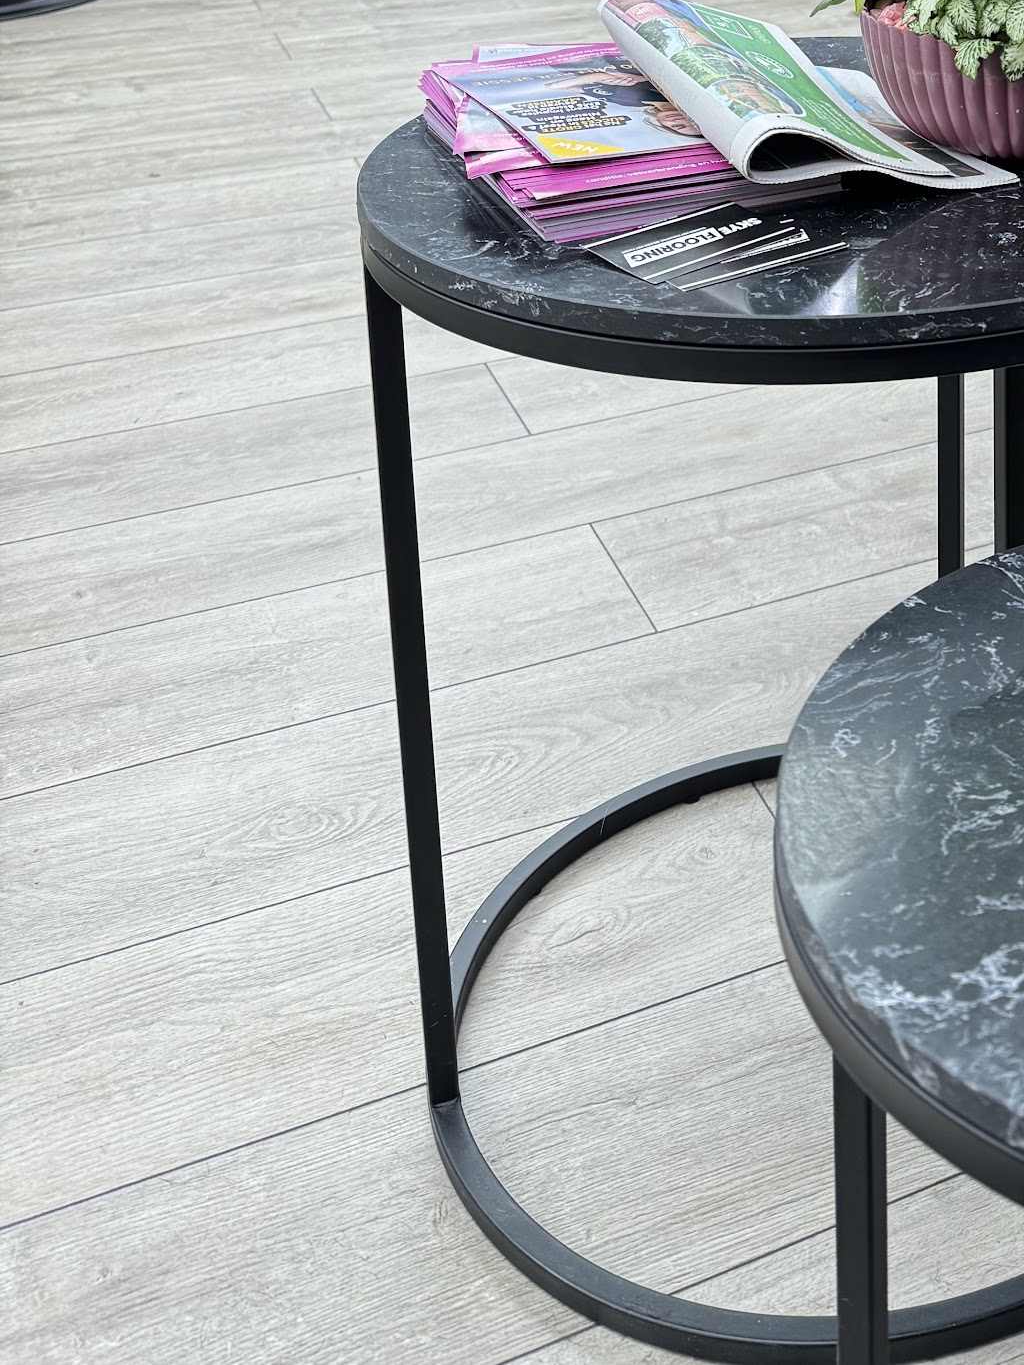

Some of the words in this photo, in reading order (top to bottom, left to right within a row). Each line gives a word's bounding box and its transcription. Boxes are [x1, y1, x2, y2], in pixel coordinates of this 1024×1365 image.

[580, 116, 625, 125] SUCCES
[551, 141, 599, 154] NEW
[716, 216, 763, 236] SKYE
[628, 230, 716, 266] FLOORING
